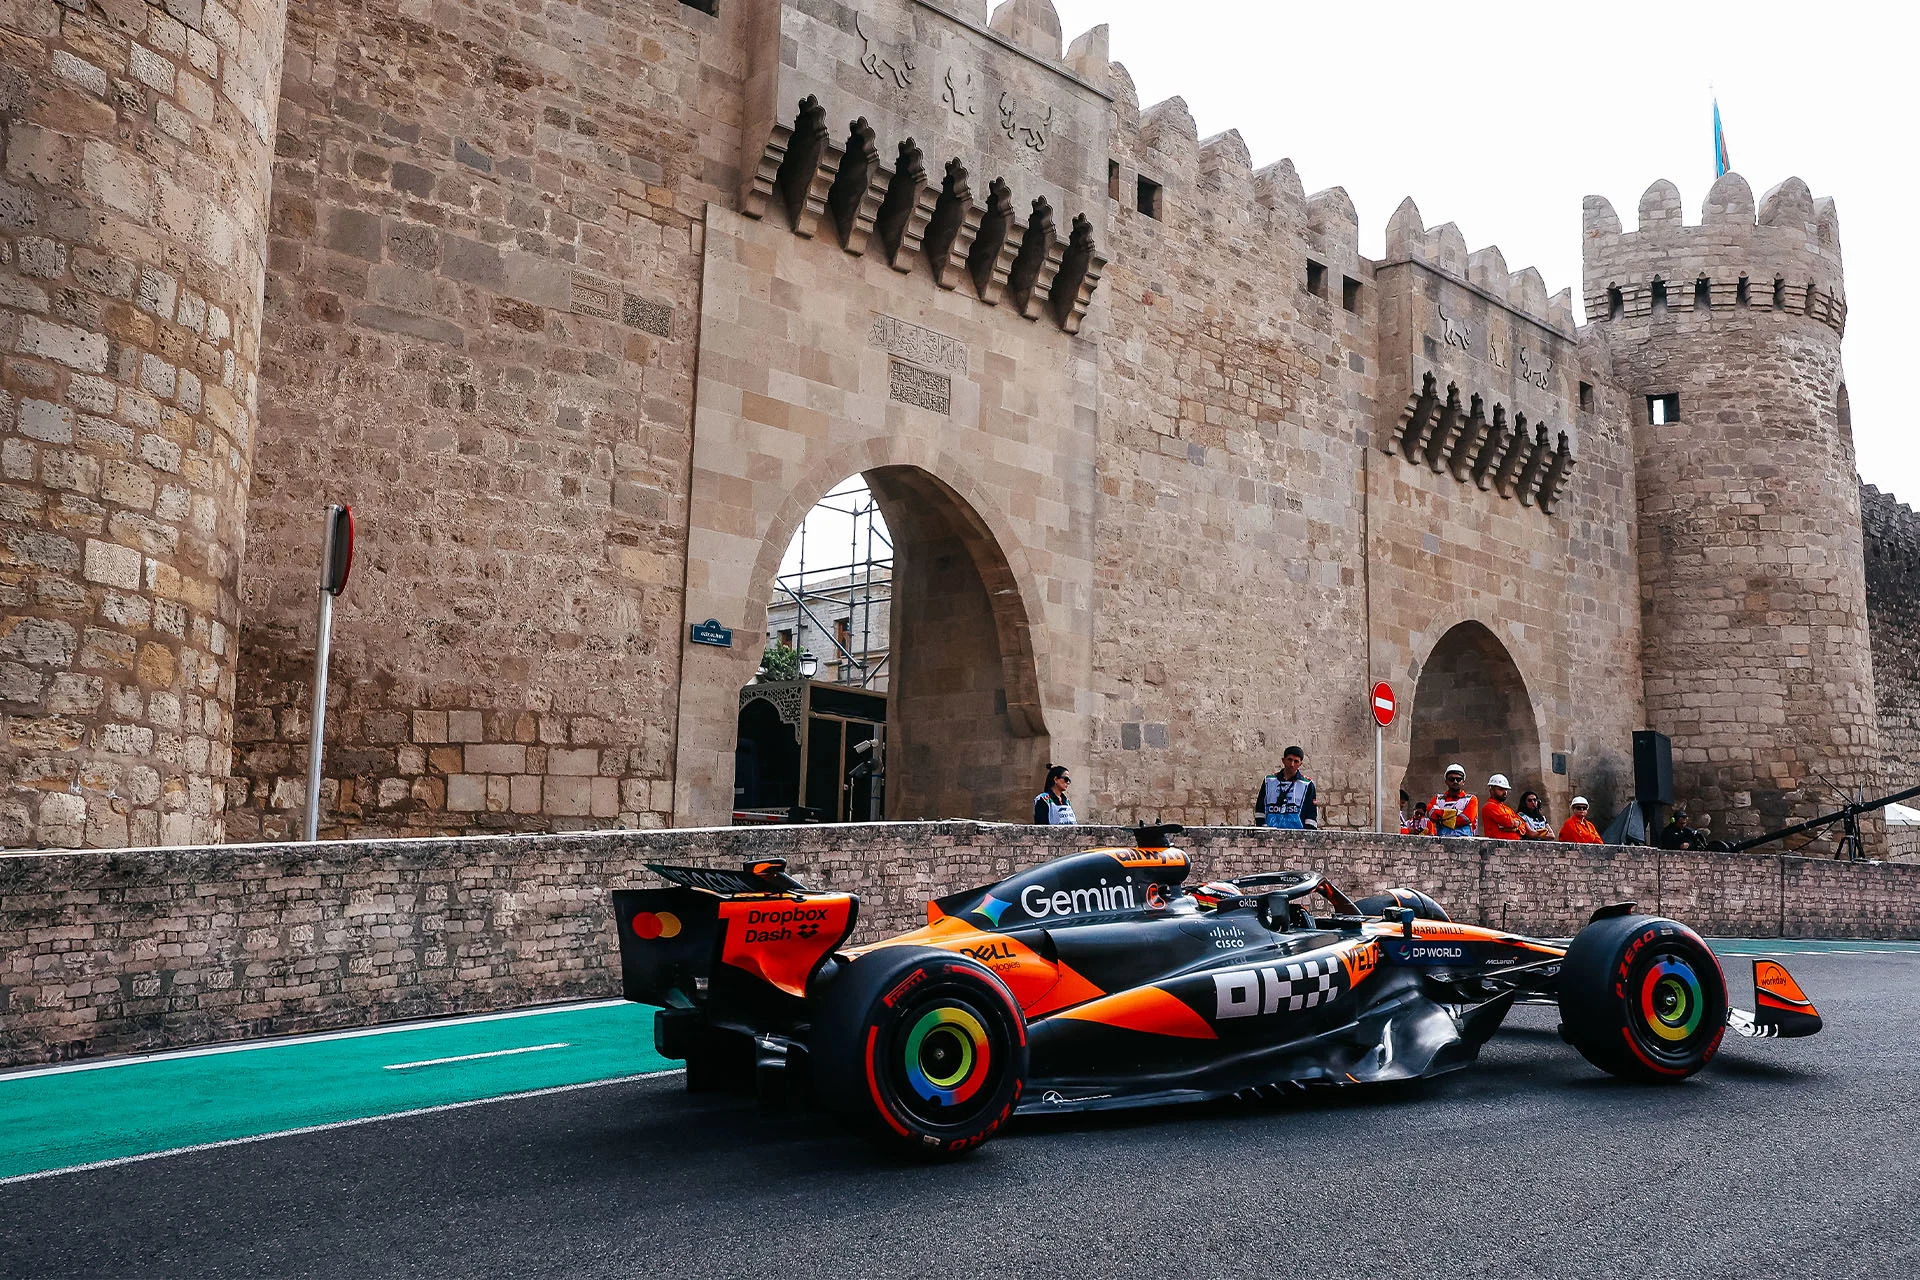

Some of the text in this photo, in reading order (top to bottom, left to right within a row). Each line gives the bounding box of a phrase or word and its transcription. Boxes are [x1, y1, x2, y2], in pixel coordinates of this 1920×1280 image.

[1268, 805, 1298, 813] COSE
[1020, 875, 1136, 918] Gemini
[1238, 898, 1258, 908] okta
[748, 908, 828, 926] Dropbox
[745, 927, 791, 943] Dash
[1439, 926, 1465, 935] MILLE
[1215, 939, 1245, 949] CISCO
[960, 942, 1017, 961] DELL
[1412, 947, 1462, 958] DP WORLD
[1618, 929, 1656, 979] ZERO
[1761, 976, 1787, 986] workday
